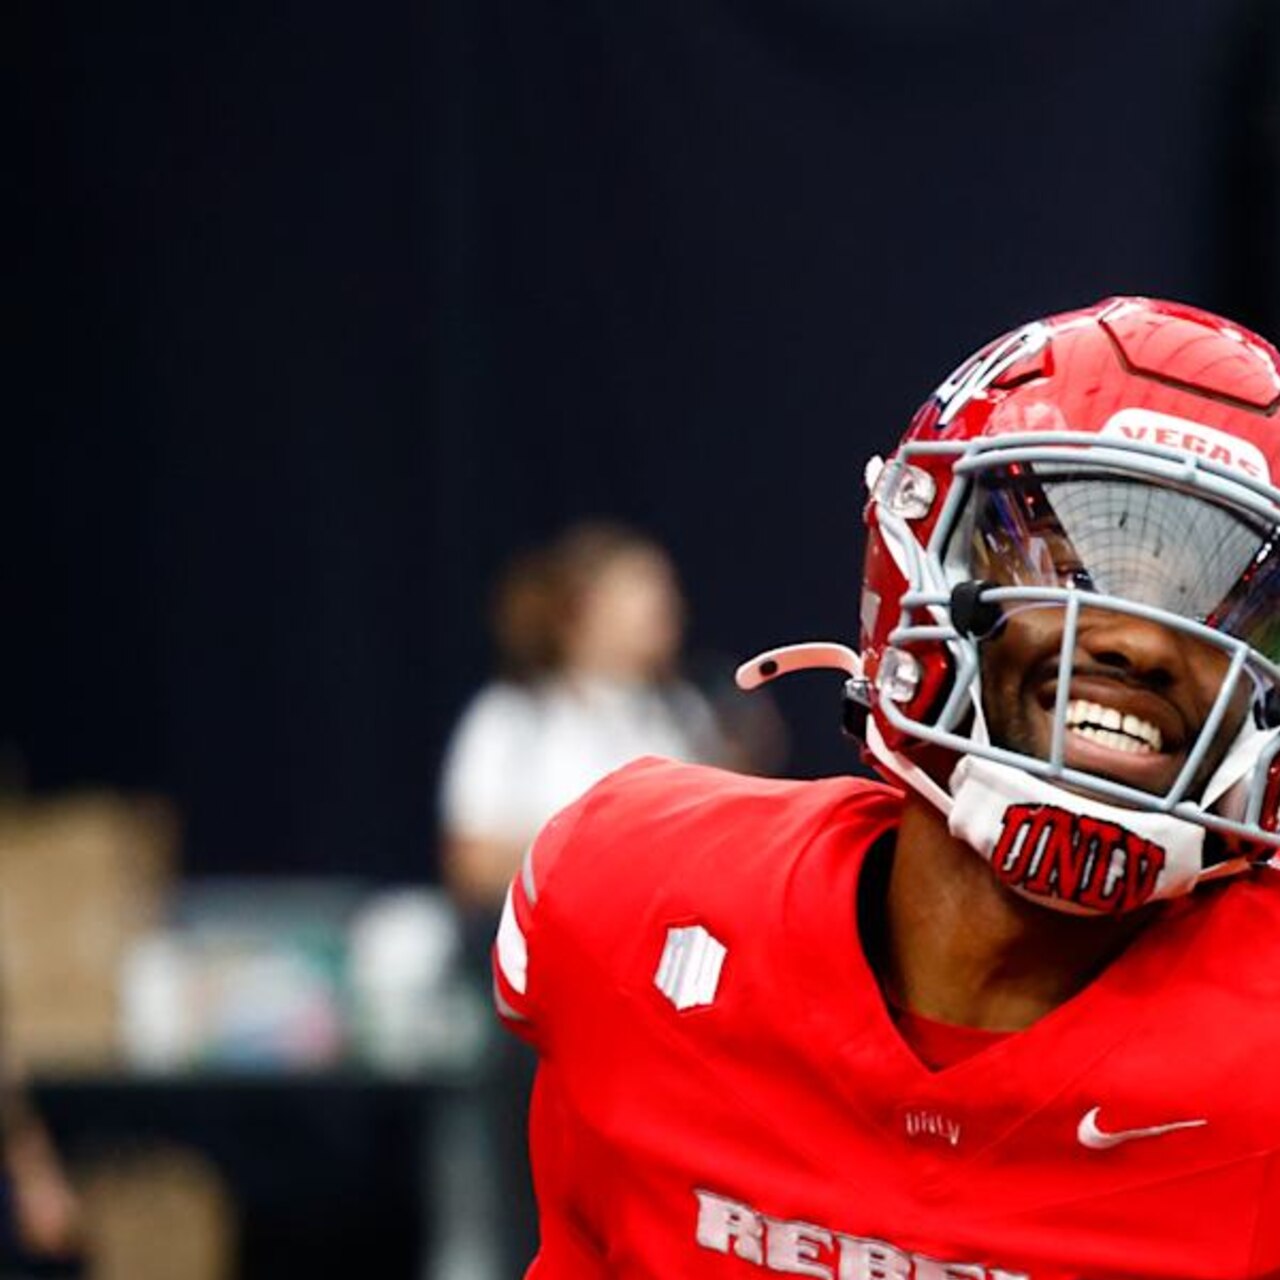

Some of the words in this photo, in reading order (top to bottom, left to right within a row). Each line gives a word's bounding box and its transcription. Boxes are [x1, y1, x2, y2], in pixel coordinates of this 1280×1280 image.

[1119, 425, 1262, 478] VEGAS
[990, 803, 1167, 917] UNLV
[903, 1110, 961, 1147] UNLV
